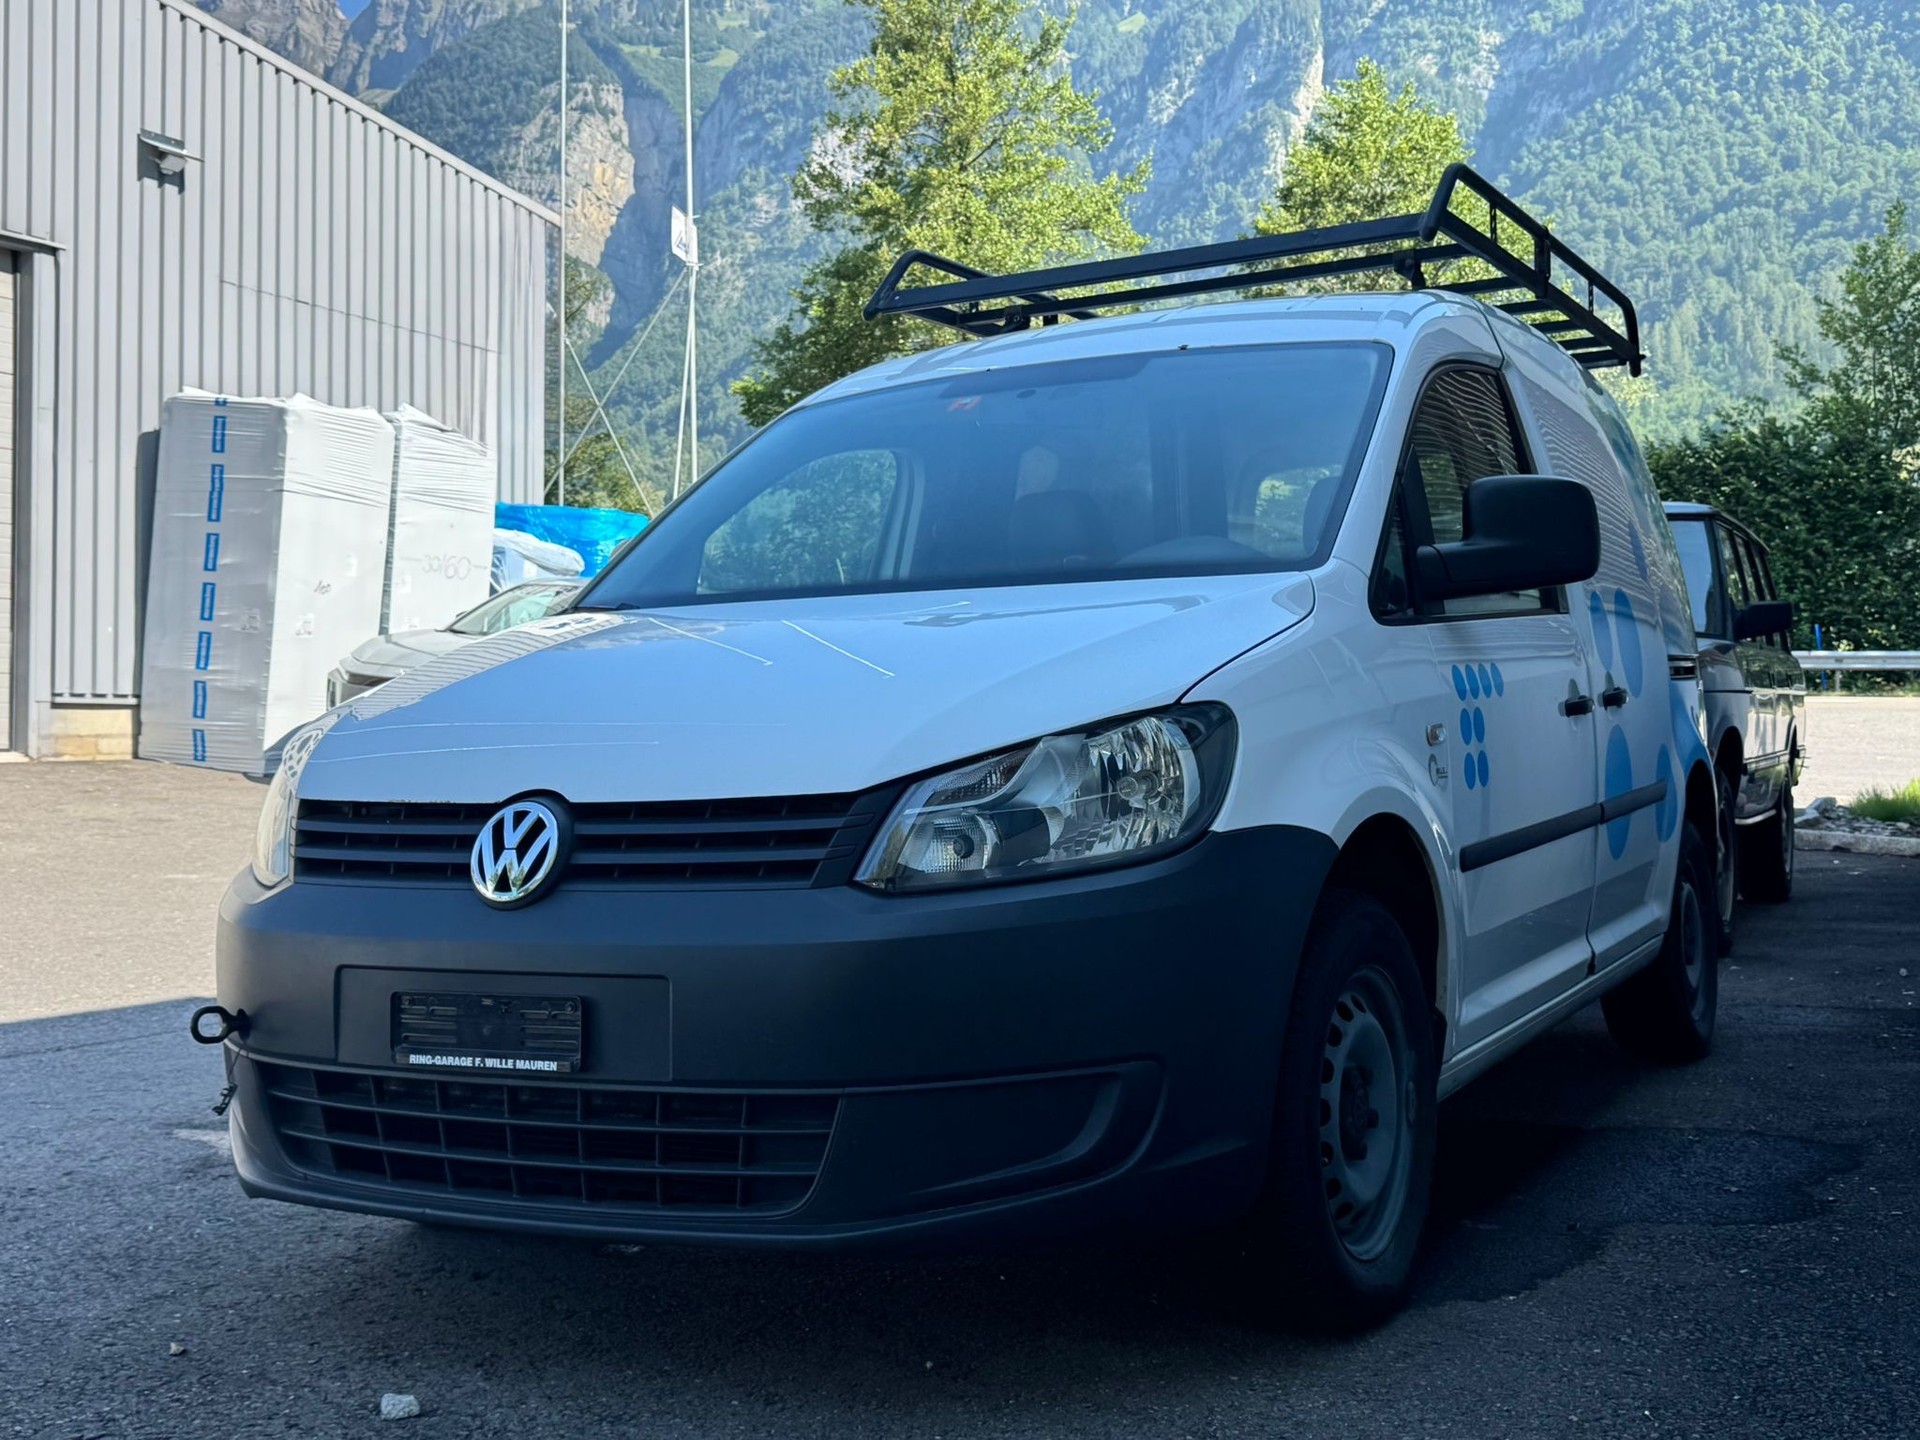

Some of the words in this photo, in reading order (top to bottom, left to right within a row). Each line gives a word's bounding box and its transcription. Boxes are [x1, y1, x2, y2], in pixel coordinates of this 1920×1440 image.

[470, 801, 559, 901] VW
[409, 1054, 473, 1067] RING-GARAGE
[475, 1058, 484, 1067] F.
[485, 1058, 514, 1069] WILLE
[515, 1060, 558, 1071] MAUREN
